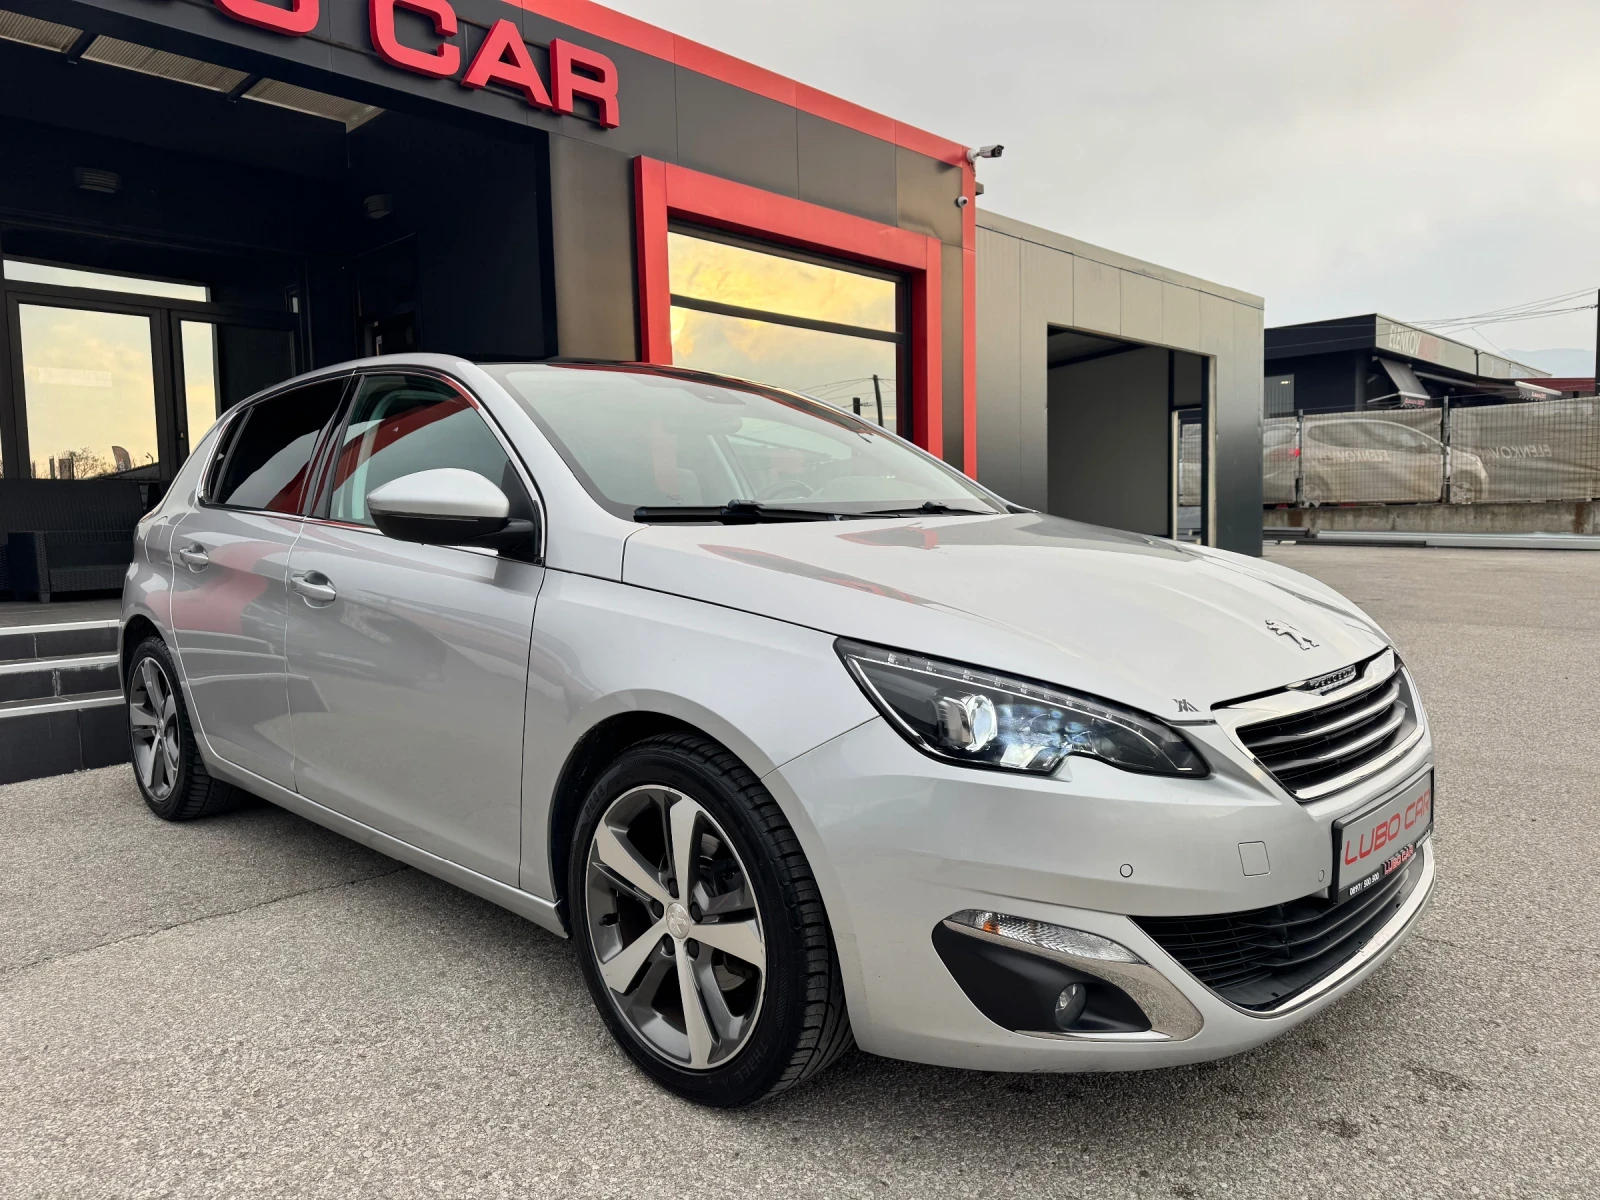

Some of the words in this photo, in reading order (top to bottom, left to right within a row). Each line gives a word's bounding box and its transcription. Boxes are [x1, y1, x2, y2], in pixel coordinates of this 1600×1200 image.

[369, 0, 619, 129] CAR
[1344, 812, 1401, 866] LUBO
[1404, 788, 1431, 830] CAR
